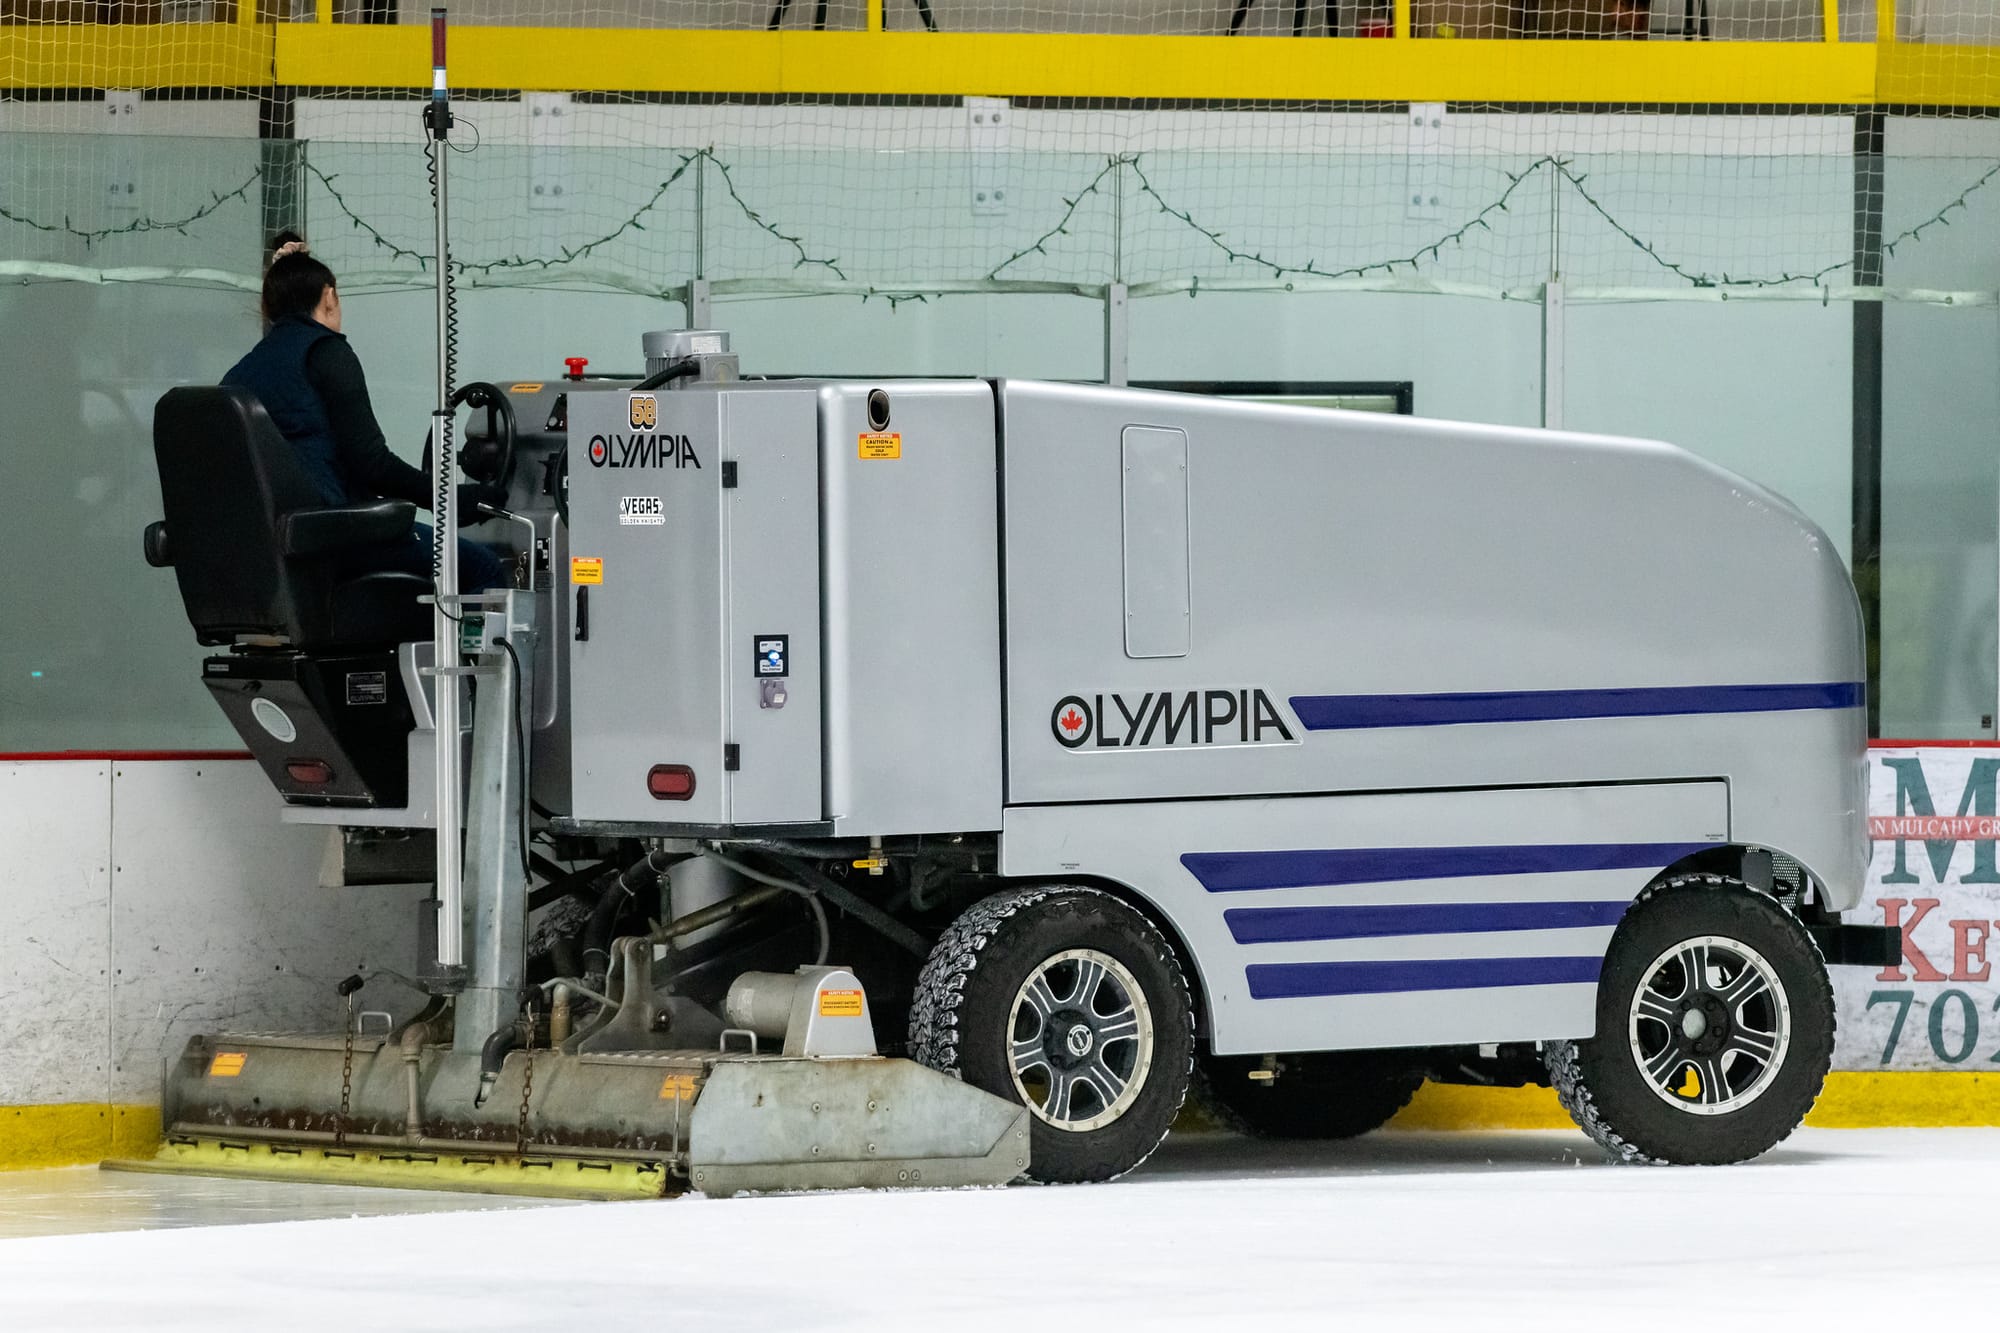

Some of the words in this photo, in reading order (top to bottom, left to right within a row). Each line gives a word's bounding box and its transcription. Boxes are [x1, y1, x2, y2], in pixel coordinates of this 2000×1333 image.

[629, 396, 657, 430] 58
[588, 434, 702, 469] OLYMPIA
[623, 497, 659, 517] VEGAS
[1051, 688, 1295, 749] OLYMPIA
[1890, 819, 1975, 836] MULCAHY
[1876, 898, 2000, 982] KE
[1866, 988, 2000, 1065] 70
